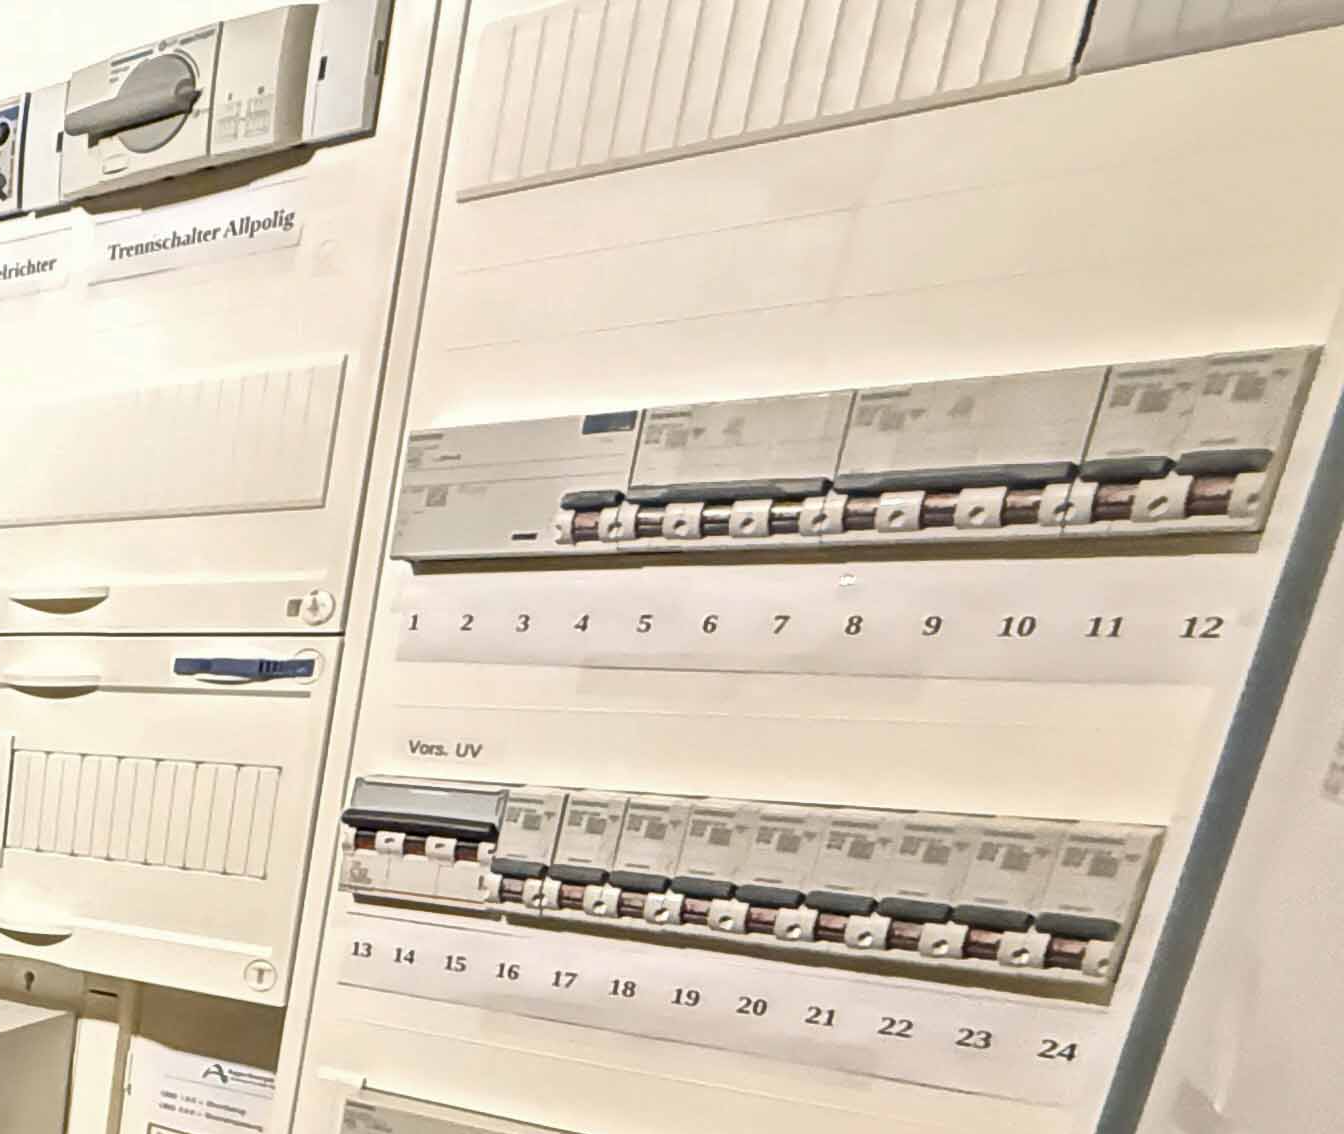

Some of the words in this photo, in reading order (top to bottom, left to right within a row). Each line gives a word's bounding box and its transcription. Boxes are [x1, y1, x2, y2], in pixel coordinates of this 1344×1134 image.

[107, 226, 220, 262] Trennschalter
[223, 208, 296, 240] Allpolig
[408, 613, 418, 631] 1
[460, 613, 474, 632] 2
[515, 614, 531, 633] 3
[573, 614, 590, 632] 4
[636, 614, 653, 633] 5
[702, 614, 719, 634] 6
[773, 614, 791, 635] 7
[844, 615, 864, 636] 8
[921, 615, 943, 637] 9
[997, 616, 1037, 638] 10
[1085, 616, 1123, 638] 11
[1179, 616, 1225, 639] 12
[454, 742, 484, 760] UV
[351, 941, 373, 958] 13
[393, 947, 416, 965] 14
[444, 955, 467, 973] 15
[495, 962, 521, 981] 16
[551, 970, 579, 989] 17
[609, 979, 637, 998] 18
[671, 988, 701, 1007] 19
[735, 996, 768, 1017] 20
[804, 1006, 836, 1027] 21
[877, 1016, 914, 1039] 22
[954, 1028, 993, 1050] 23
[1036, 1039, 1078, 1062] 24
